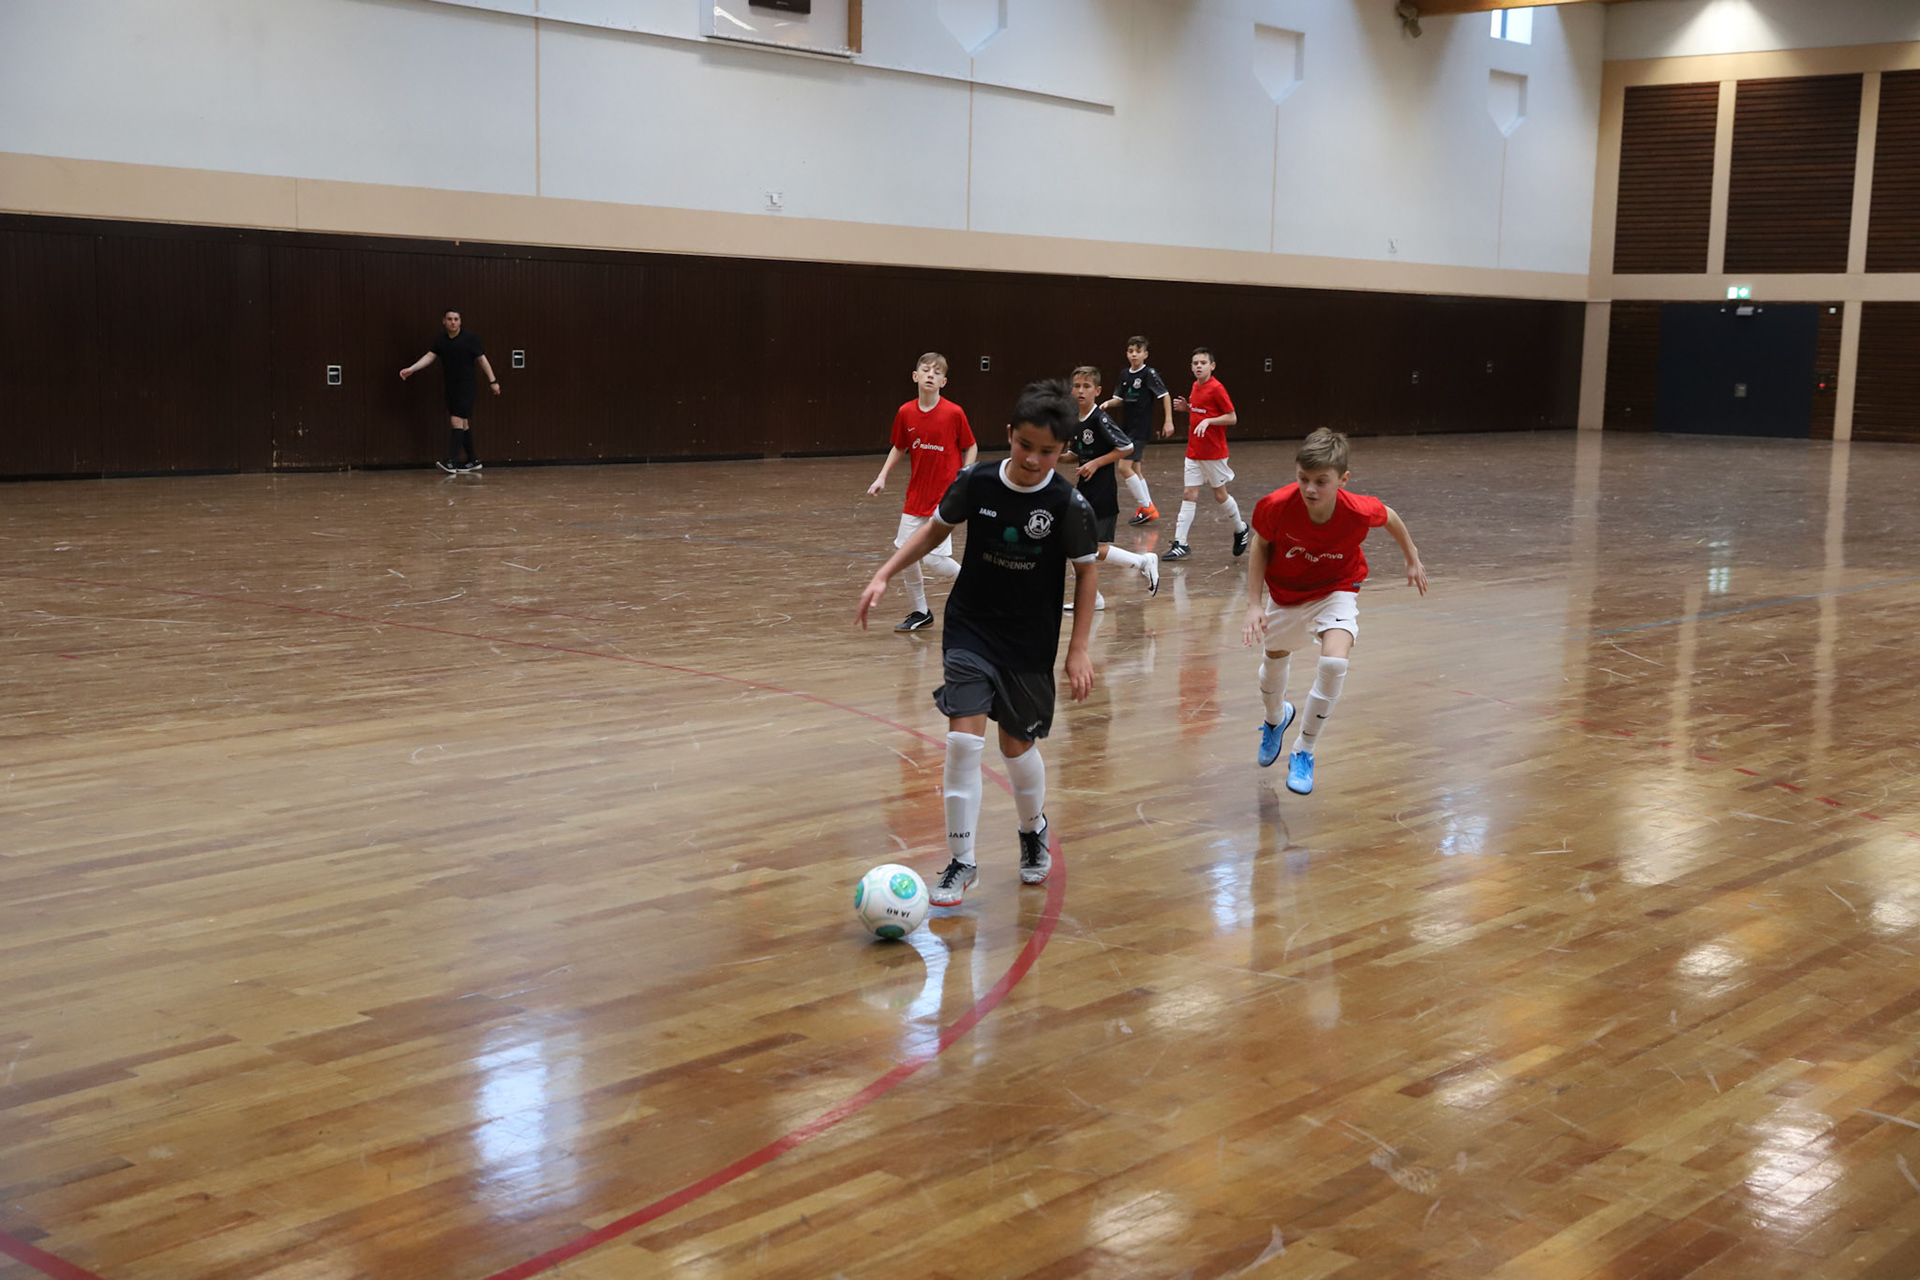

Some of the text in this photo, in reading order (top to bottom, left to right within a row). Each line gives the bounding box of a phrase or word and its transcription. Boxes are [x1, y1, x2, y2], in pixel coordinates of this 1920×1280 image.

[920, 443, 944, 452] mainova
[979, 507, 998, 518] JAKO
[1304, 552, 1344, 563] manova
[948, 831, 971, 839] JAKO
